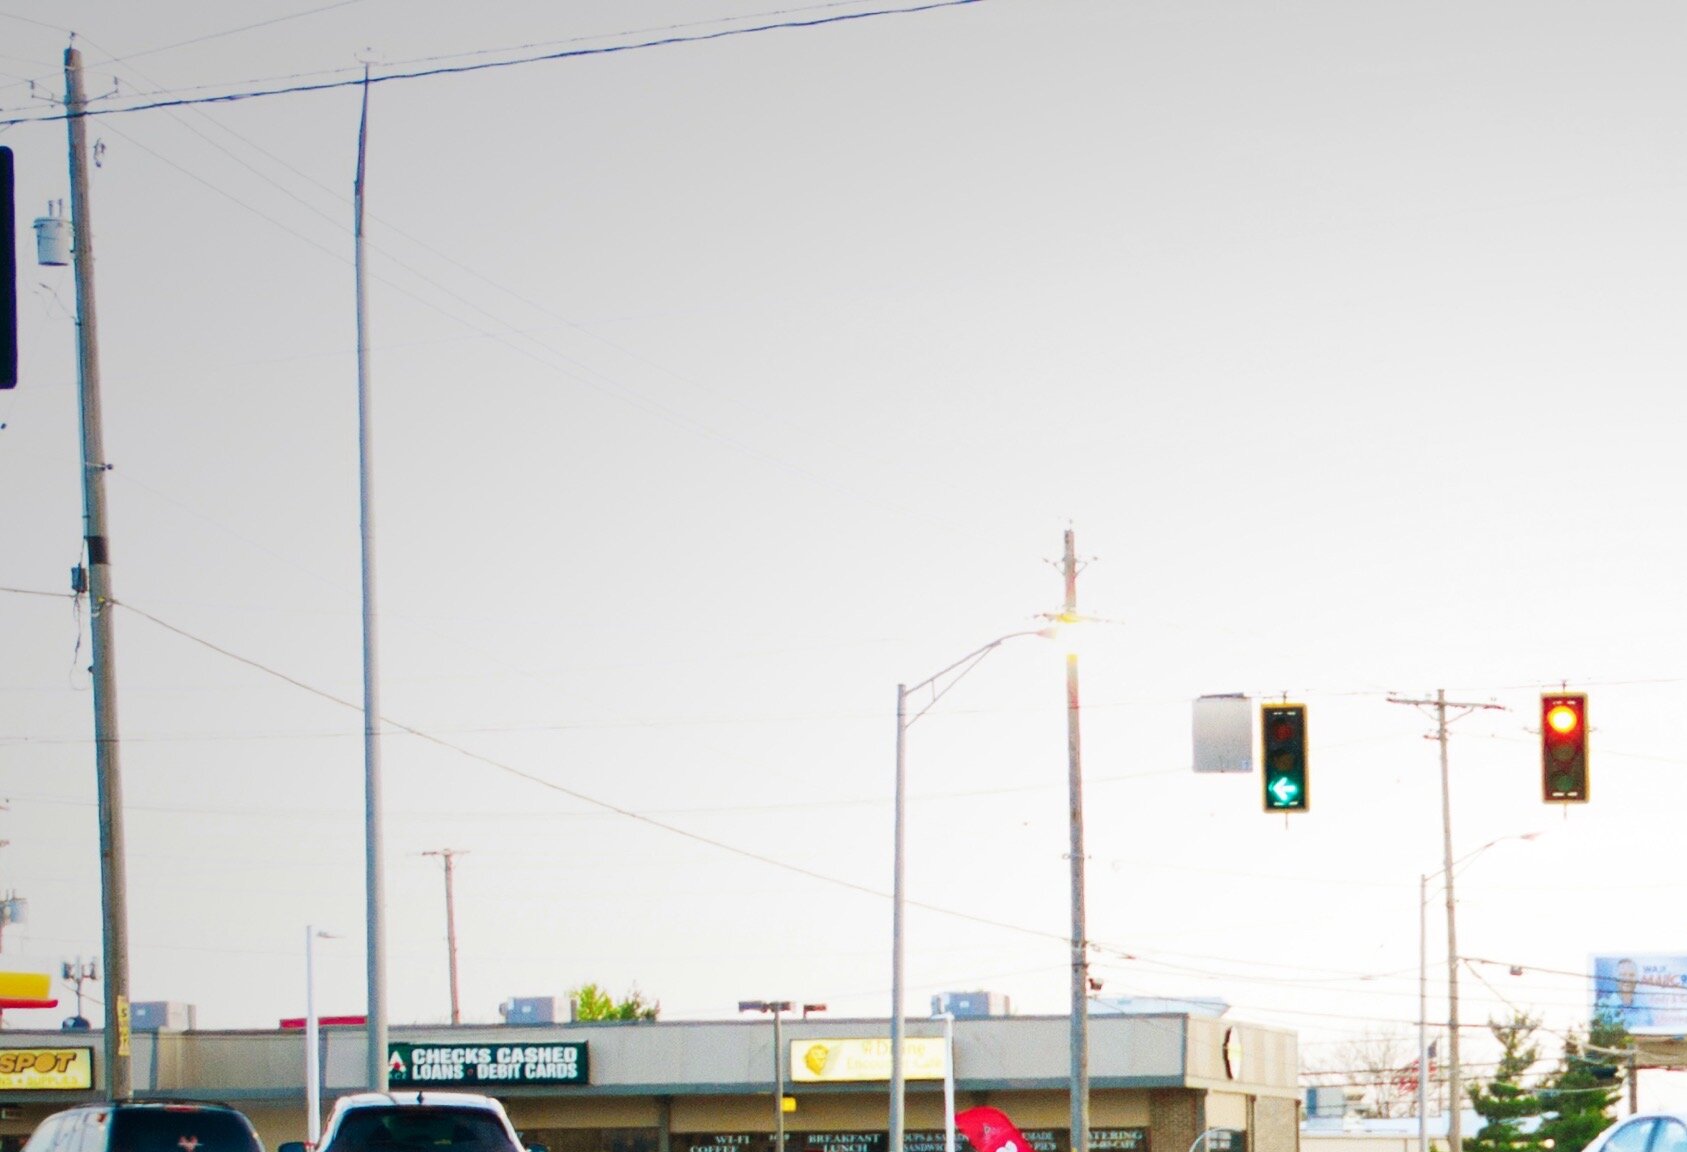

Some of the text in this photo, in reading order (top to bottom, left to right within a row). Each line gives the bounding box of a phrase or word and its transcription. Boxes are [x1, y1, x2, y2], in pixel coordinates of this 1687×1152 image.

[412, 1046, 578, 1065] CHECKS CASHED
[0, 1052, 77, 1074] SPOT
[412, 1062, 578, 1080] LOANS DEBIT CARDS
[715, 1135, 751, 1144] WI-FI
[808, 1134, 881, 1144] BREAKFAST
[1088, 1131, 1142, 1140] ATERING
[823, 1144, 868, 1152] LUNCH
